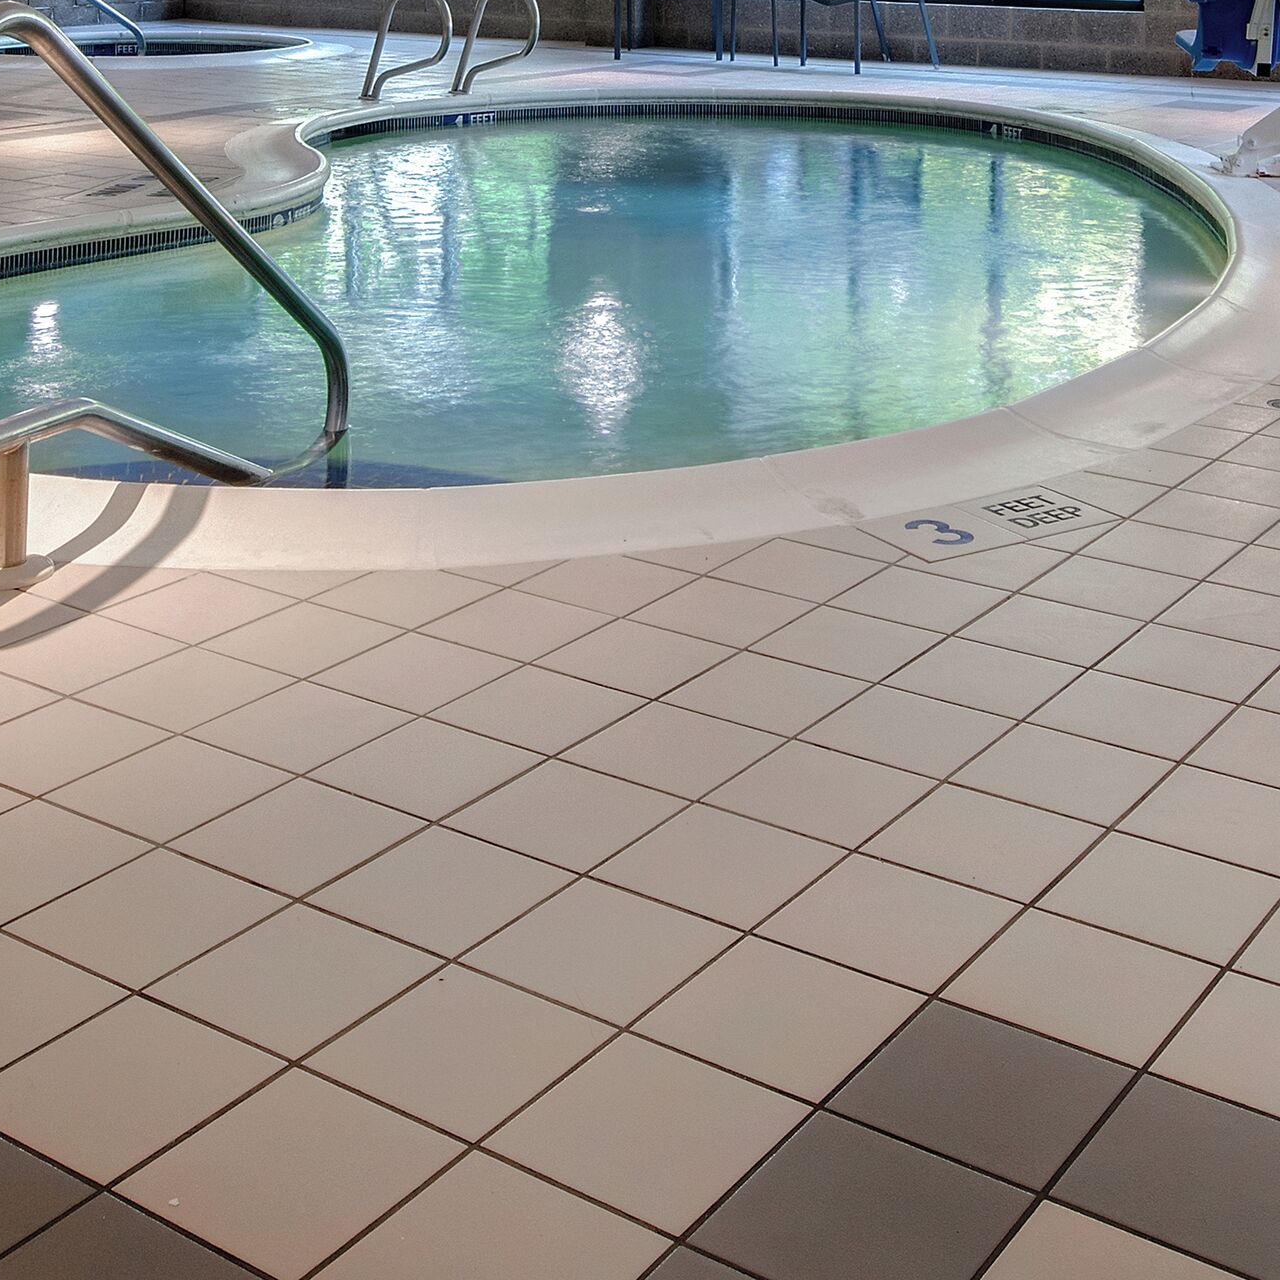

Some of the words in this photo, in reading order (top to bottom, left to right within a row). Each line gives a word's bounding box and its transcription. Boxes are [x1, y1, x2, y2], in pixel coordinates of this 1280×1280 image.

[117, 44, 138, 54] FEET
[470, 113, 495, 125] FEET
[981, 494, 1056, 517] FEET
[1006, 505, 1083, 529] DEEP
[904, 519, 975, 545] 3
